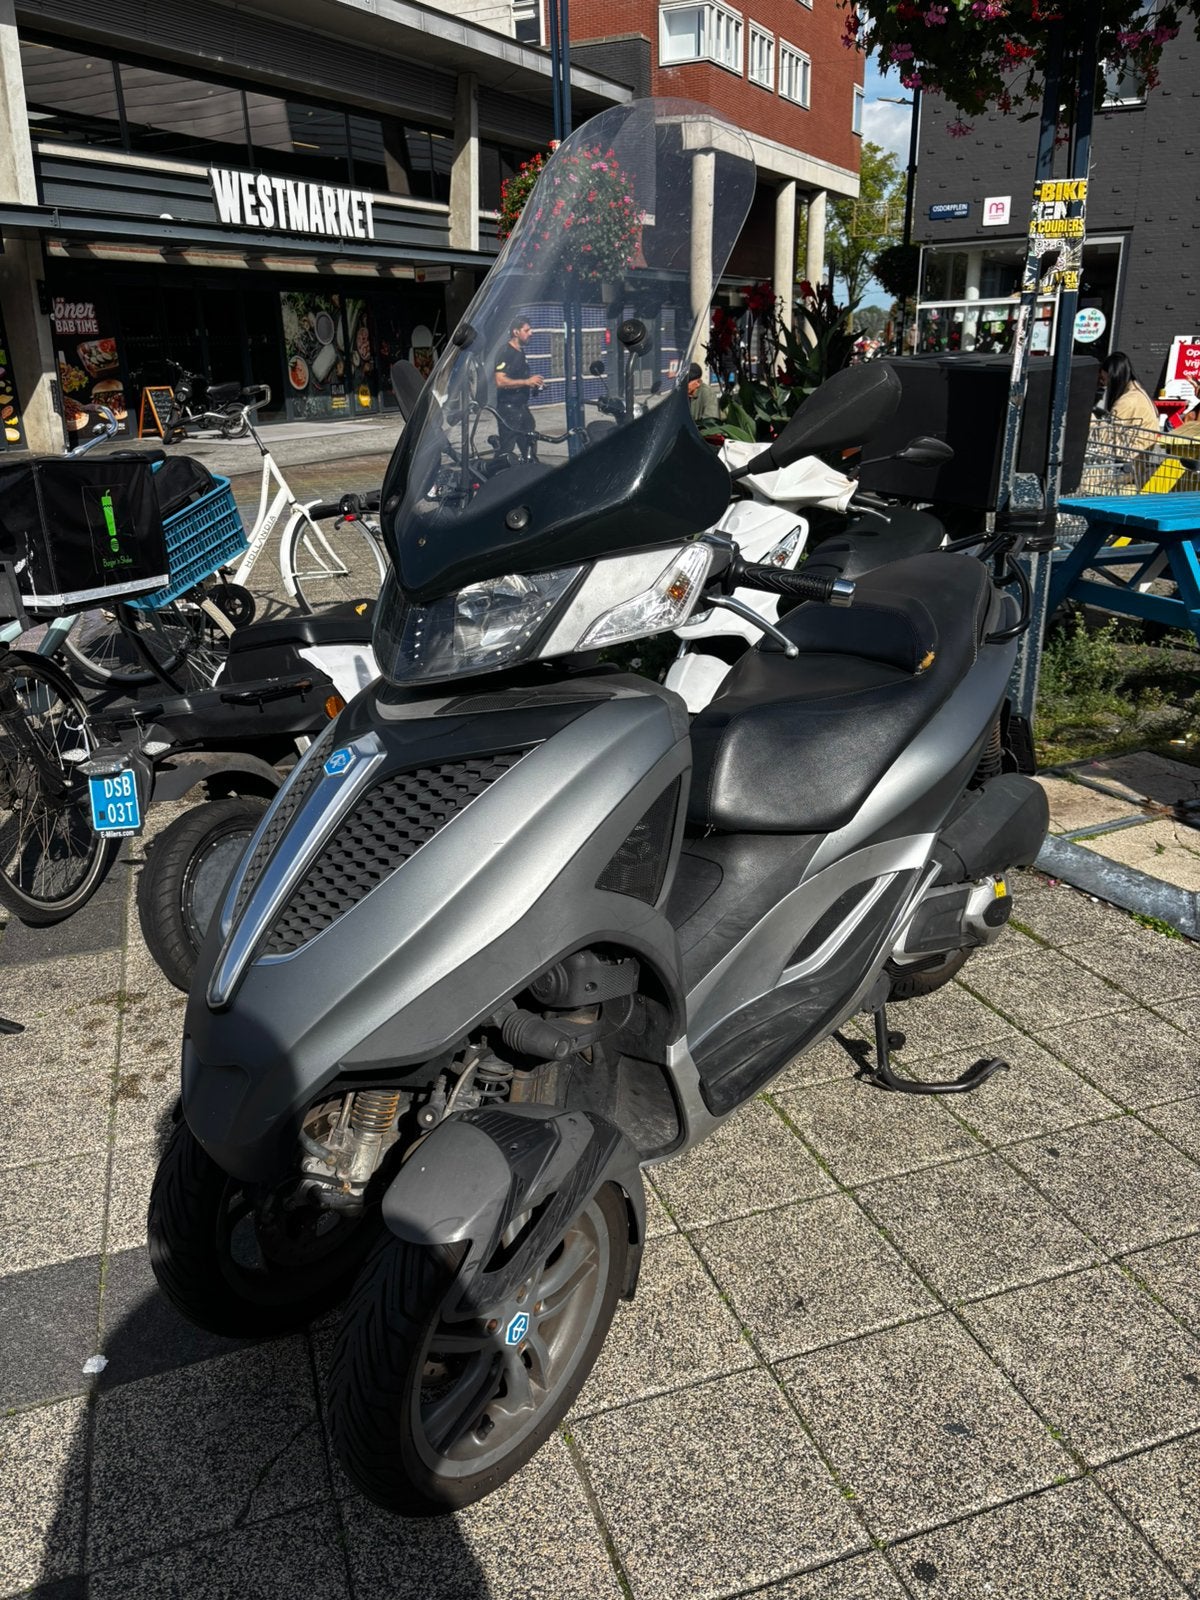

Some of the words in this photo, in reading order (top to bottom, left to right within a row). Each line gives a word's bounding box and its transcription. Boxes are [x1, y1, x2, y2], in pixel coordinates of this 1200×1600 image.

[210, 167, 375, 239] WESTMARKET
[932, 203, 968, 212] OSDORPPLEIN
[1037, 218, 1084, 233] COURIERS
[51, 297, 96, 319] öner
[55, 319, 76, 334] BAB
[76, 319, 99, 334] TIME
[1186, 348, 1200, 358] Op
[244, 515, 278, 569] HOLLANDIA
[104, 776, 131, 798] DSB
[107, 802, 133, 823] 03T
